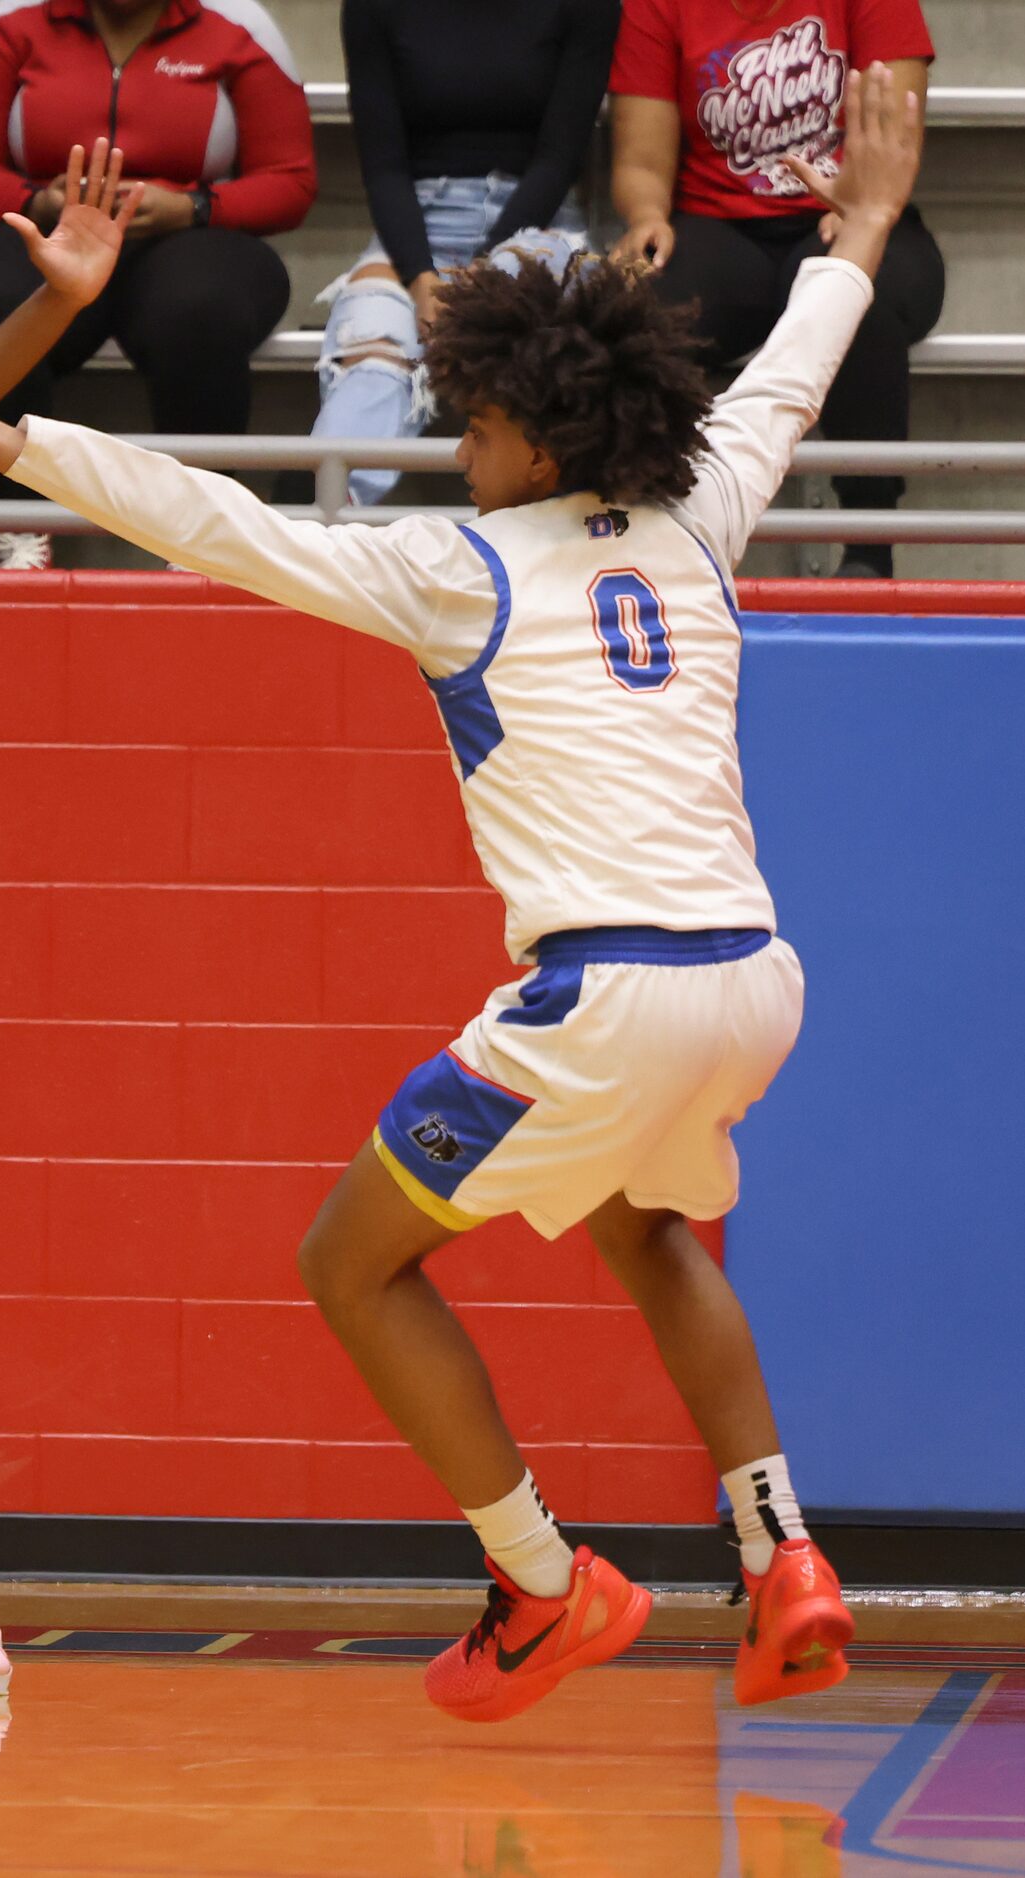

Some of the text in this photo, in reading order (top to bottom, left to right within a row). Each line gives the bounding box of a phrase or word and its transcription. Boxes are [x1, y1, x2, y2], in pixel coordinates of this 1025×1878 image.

[736, 21, 820, 91] Phil
[733, 102, 828, 165] Classic
[586, 567, 679, 694] 0
